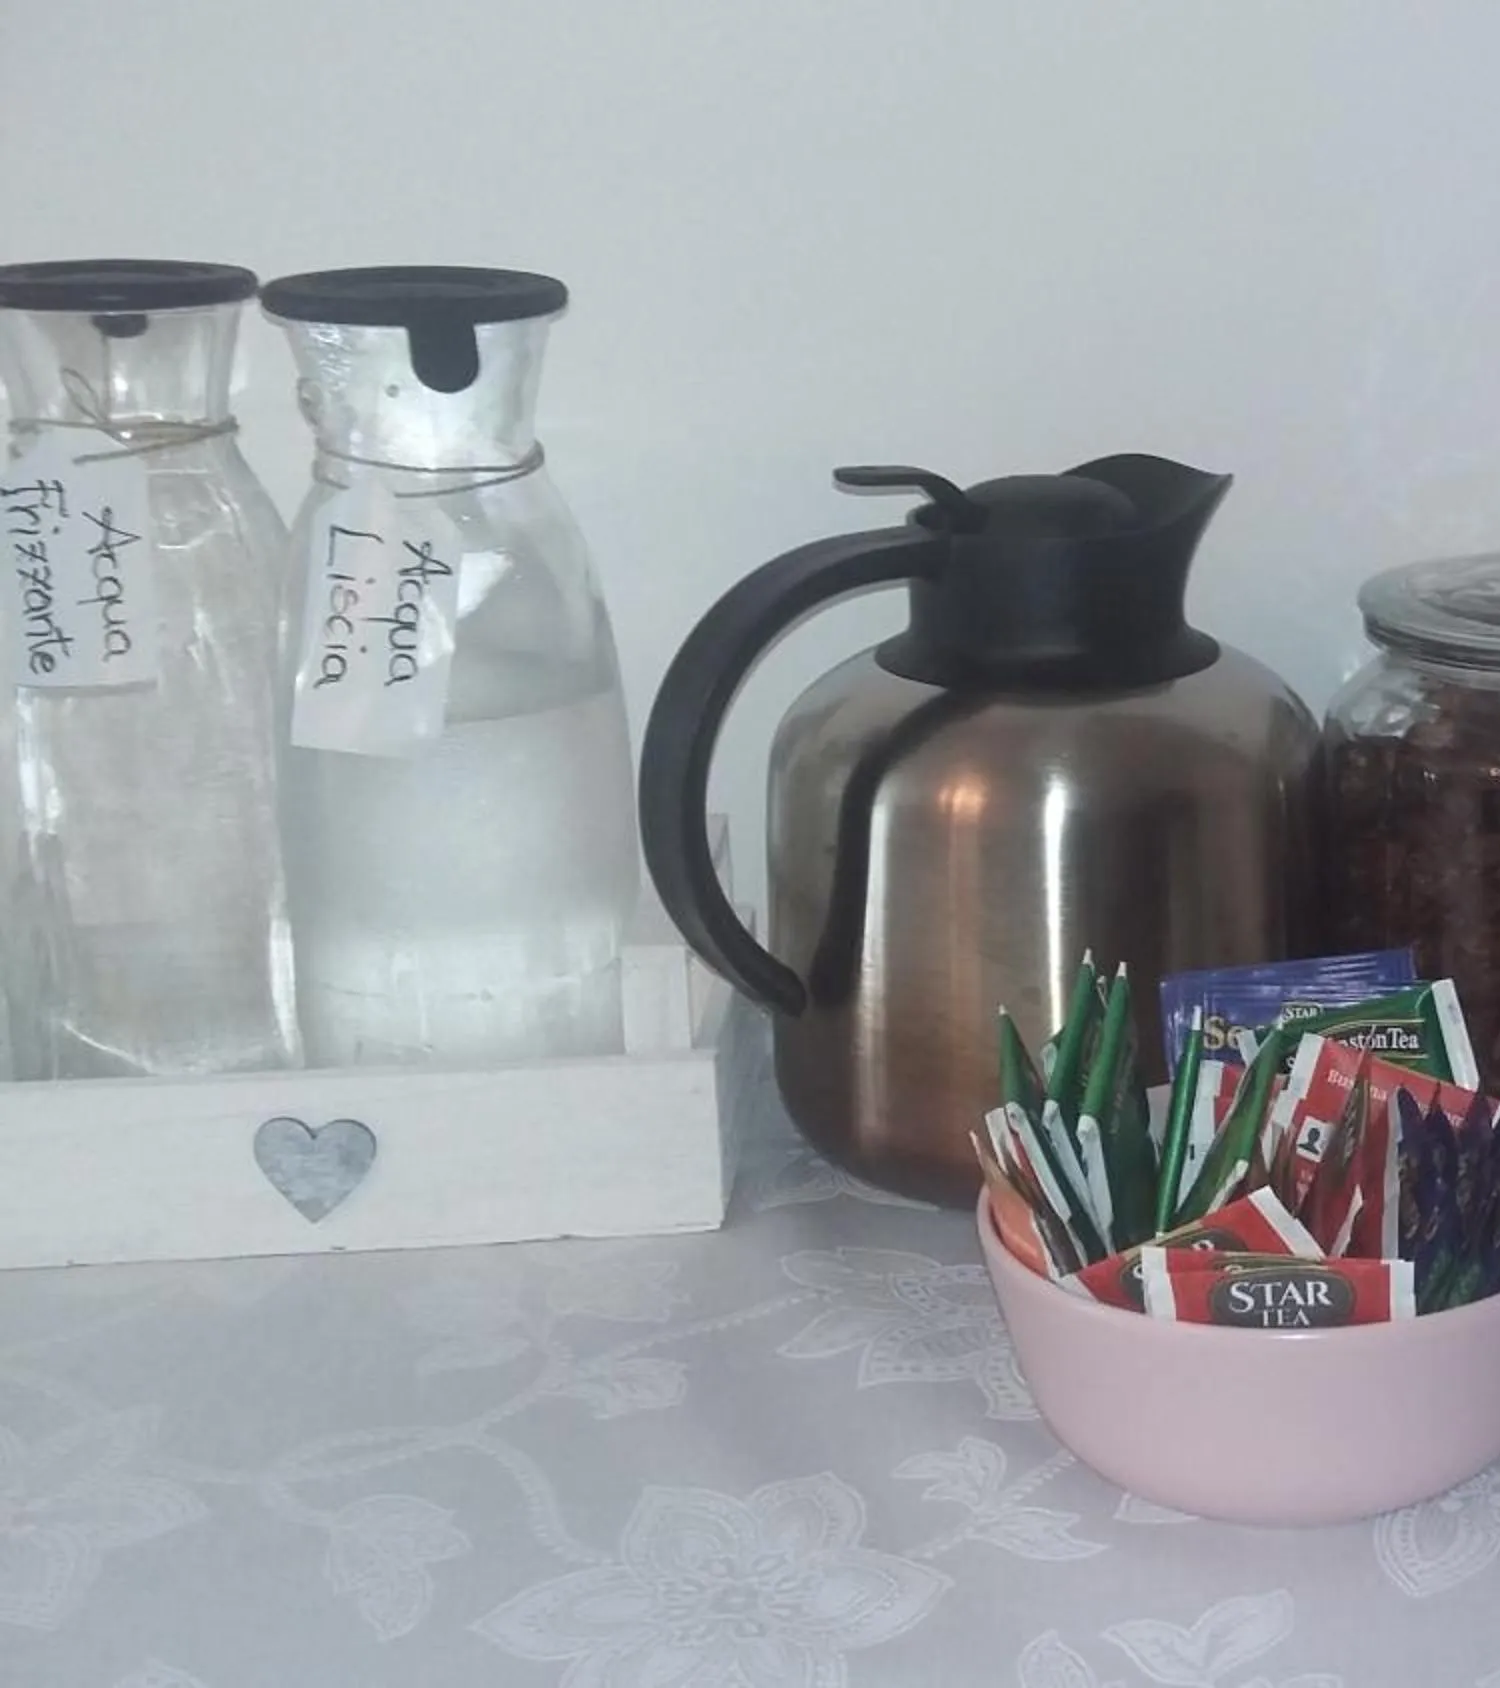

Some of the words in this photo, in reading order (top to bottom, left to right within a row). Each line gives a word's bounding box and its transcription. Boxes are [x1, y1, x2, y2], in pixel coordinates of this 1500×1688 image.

[0, 480, 74, 675] Frizzante
[77, 506, 142, 662] Acqua
[313, 525, 384, 690] Liscia
[363, 541, 452, 687] Acqua
[1285, 1007, 1318, 1019] STAR
[1386, 1027, 1419, 1049] Tea
[1229, 1280, 1333, 1313] STAR
[1261, 1308, 1311, 1328] TEA
